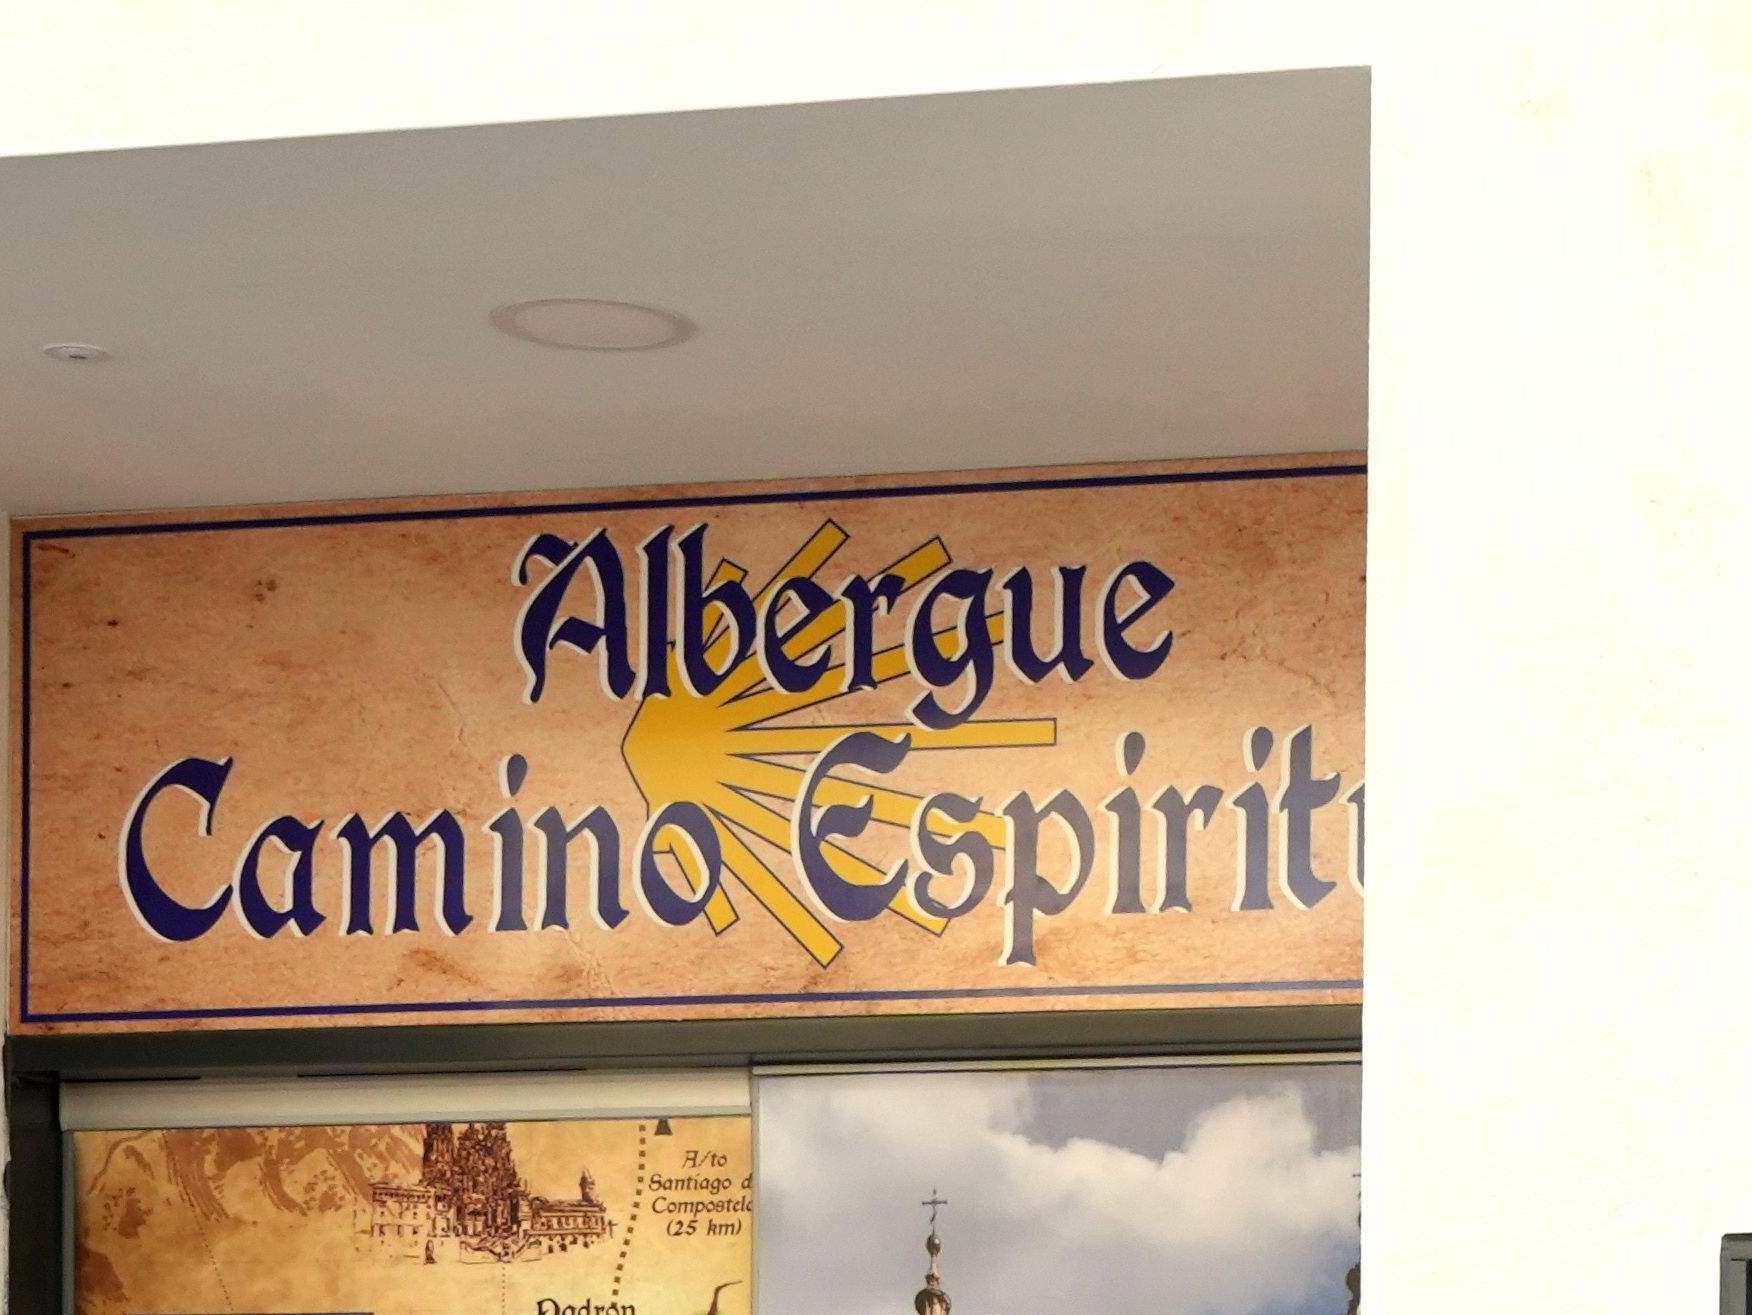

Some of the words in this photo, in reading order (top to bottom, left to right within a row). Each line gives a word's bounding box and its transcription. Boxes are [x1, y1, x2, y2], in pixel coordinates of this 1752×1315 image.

[514, 521, 1176, 731] Albergue
[119, 753, 724, 944] Camino
[648, 1173, 732, 1195] Santiago
[666, 1219, 698, 1237] (25
[706, 1218, 742, 1237] km)
